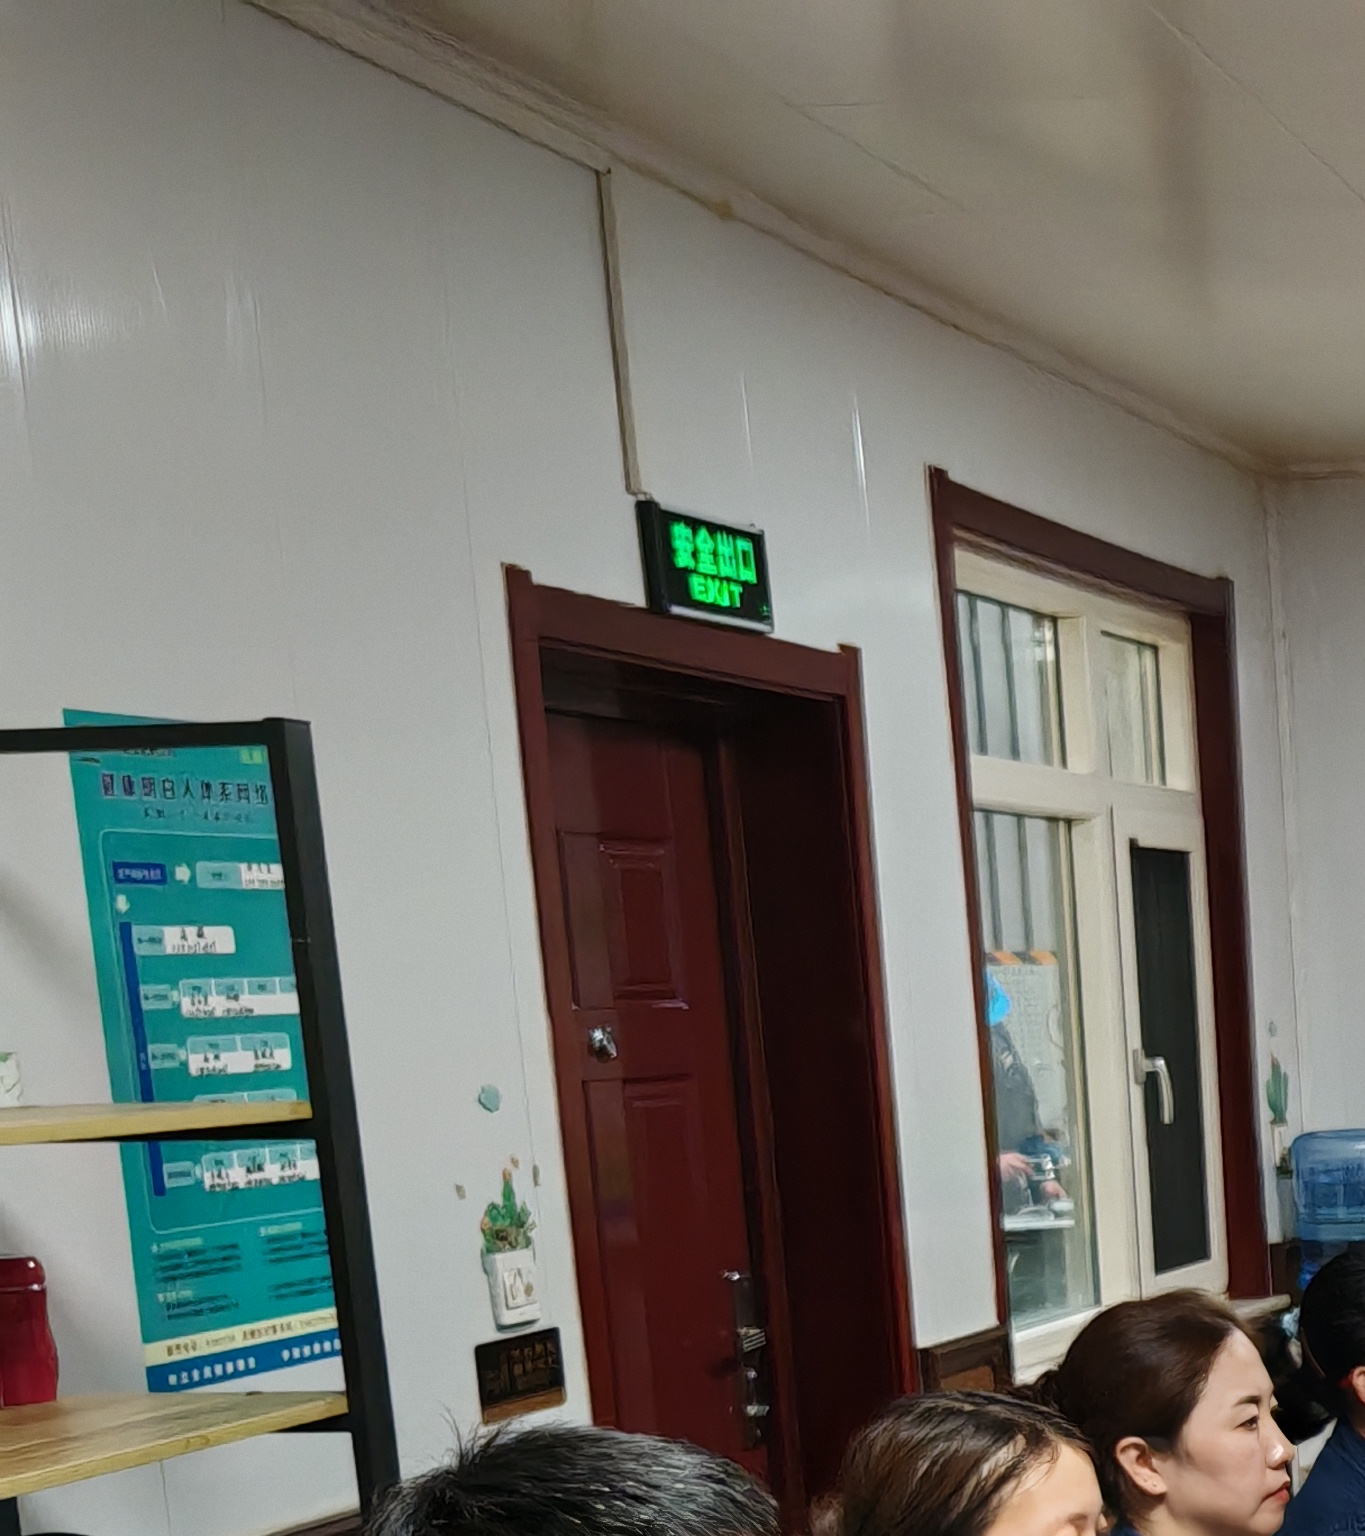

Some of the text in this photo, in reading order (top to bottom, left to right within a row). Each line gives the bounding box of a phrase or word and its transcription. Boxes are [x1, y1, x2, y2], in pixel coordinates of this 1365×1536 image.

[670, 520, 757, 584] 安全出口
[688, 572, 743, 608] EXIT
